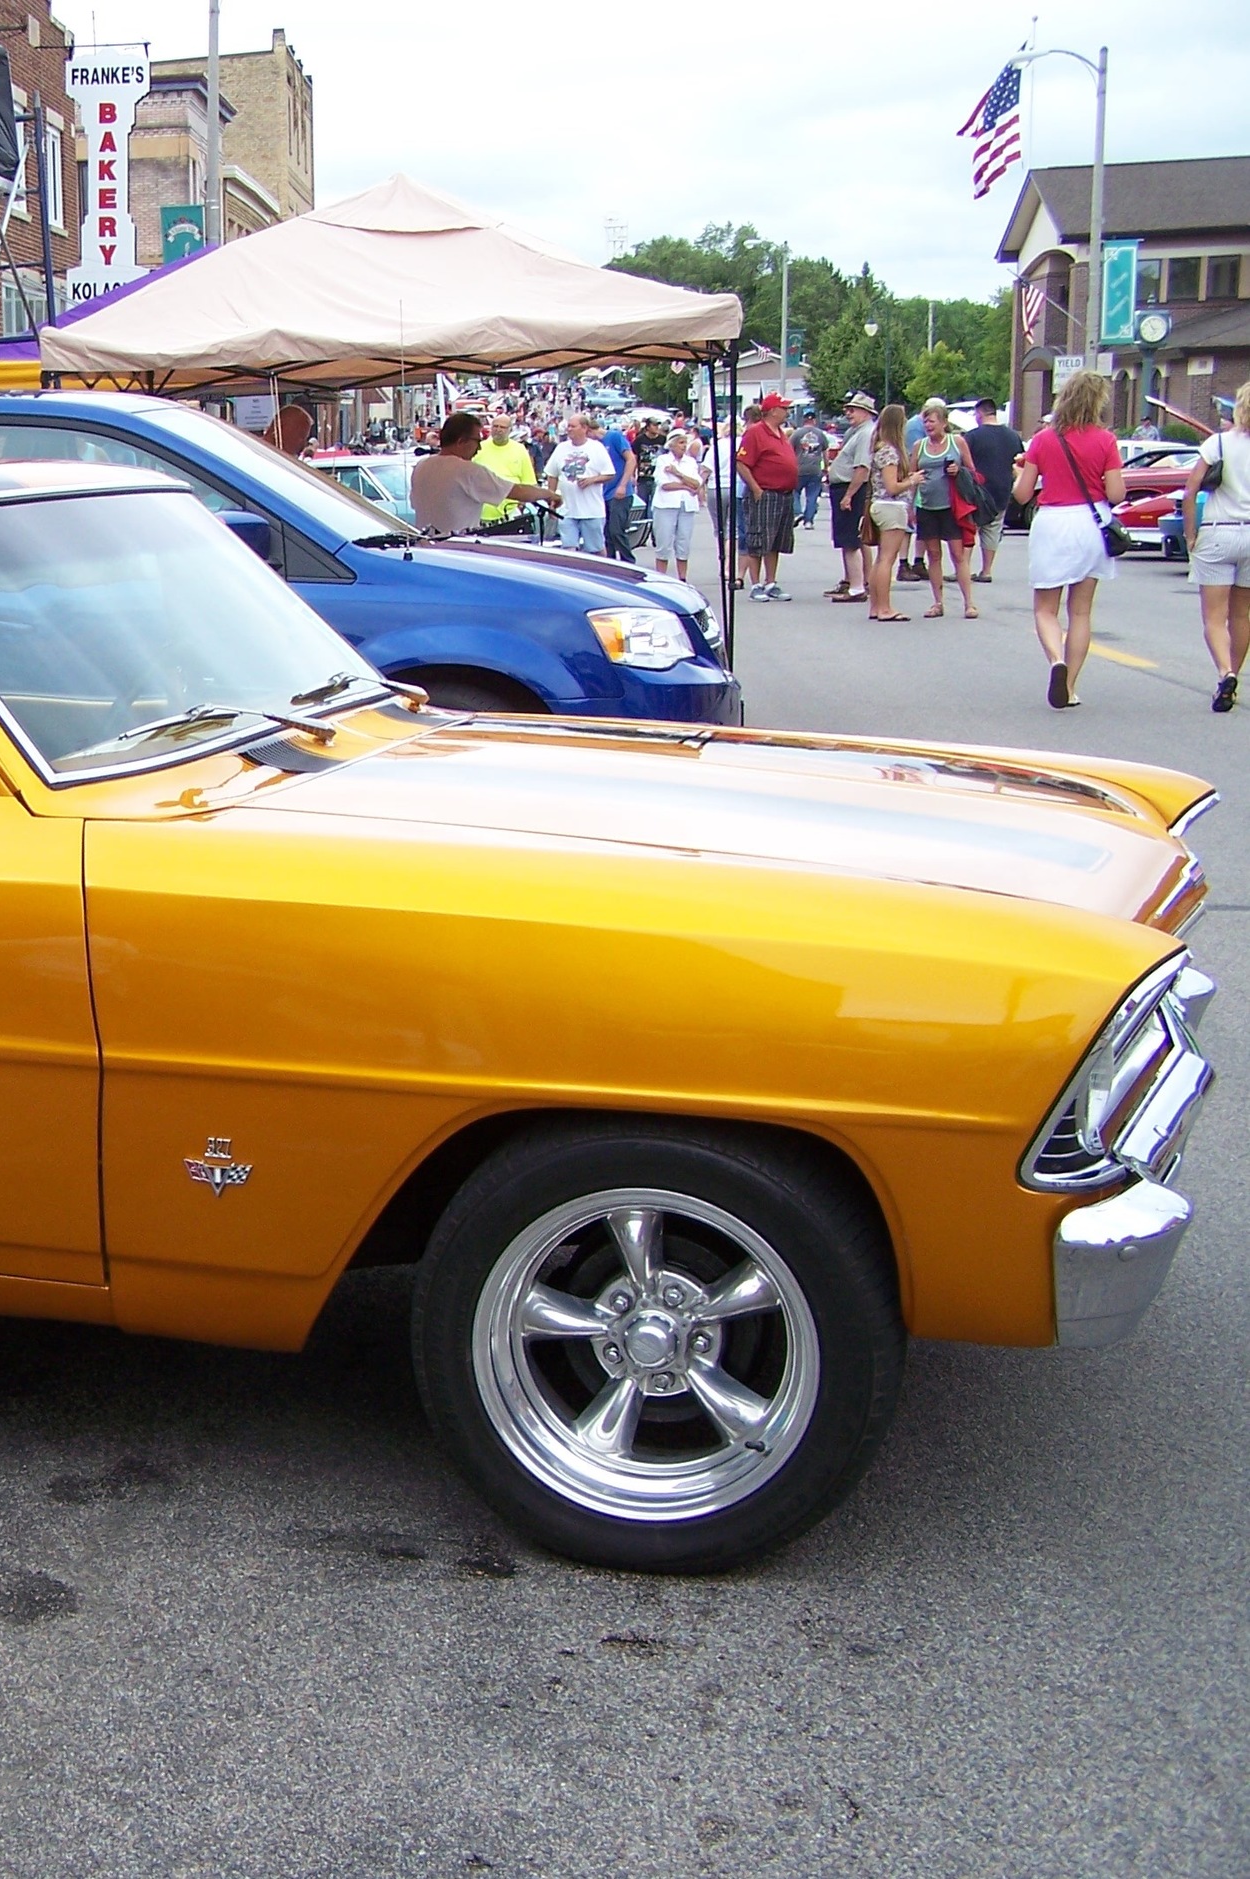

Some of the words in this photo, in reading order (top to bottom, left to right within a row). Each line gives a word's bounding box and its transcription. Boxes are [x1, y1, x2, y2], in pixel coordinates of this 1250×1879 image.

[71, 66, 144, 85] FRANKE'S
[99, 103, 117, 265] BAKERY
[1057, 358, 1081, 368] YIELD
